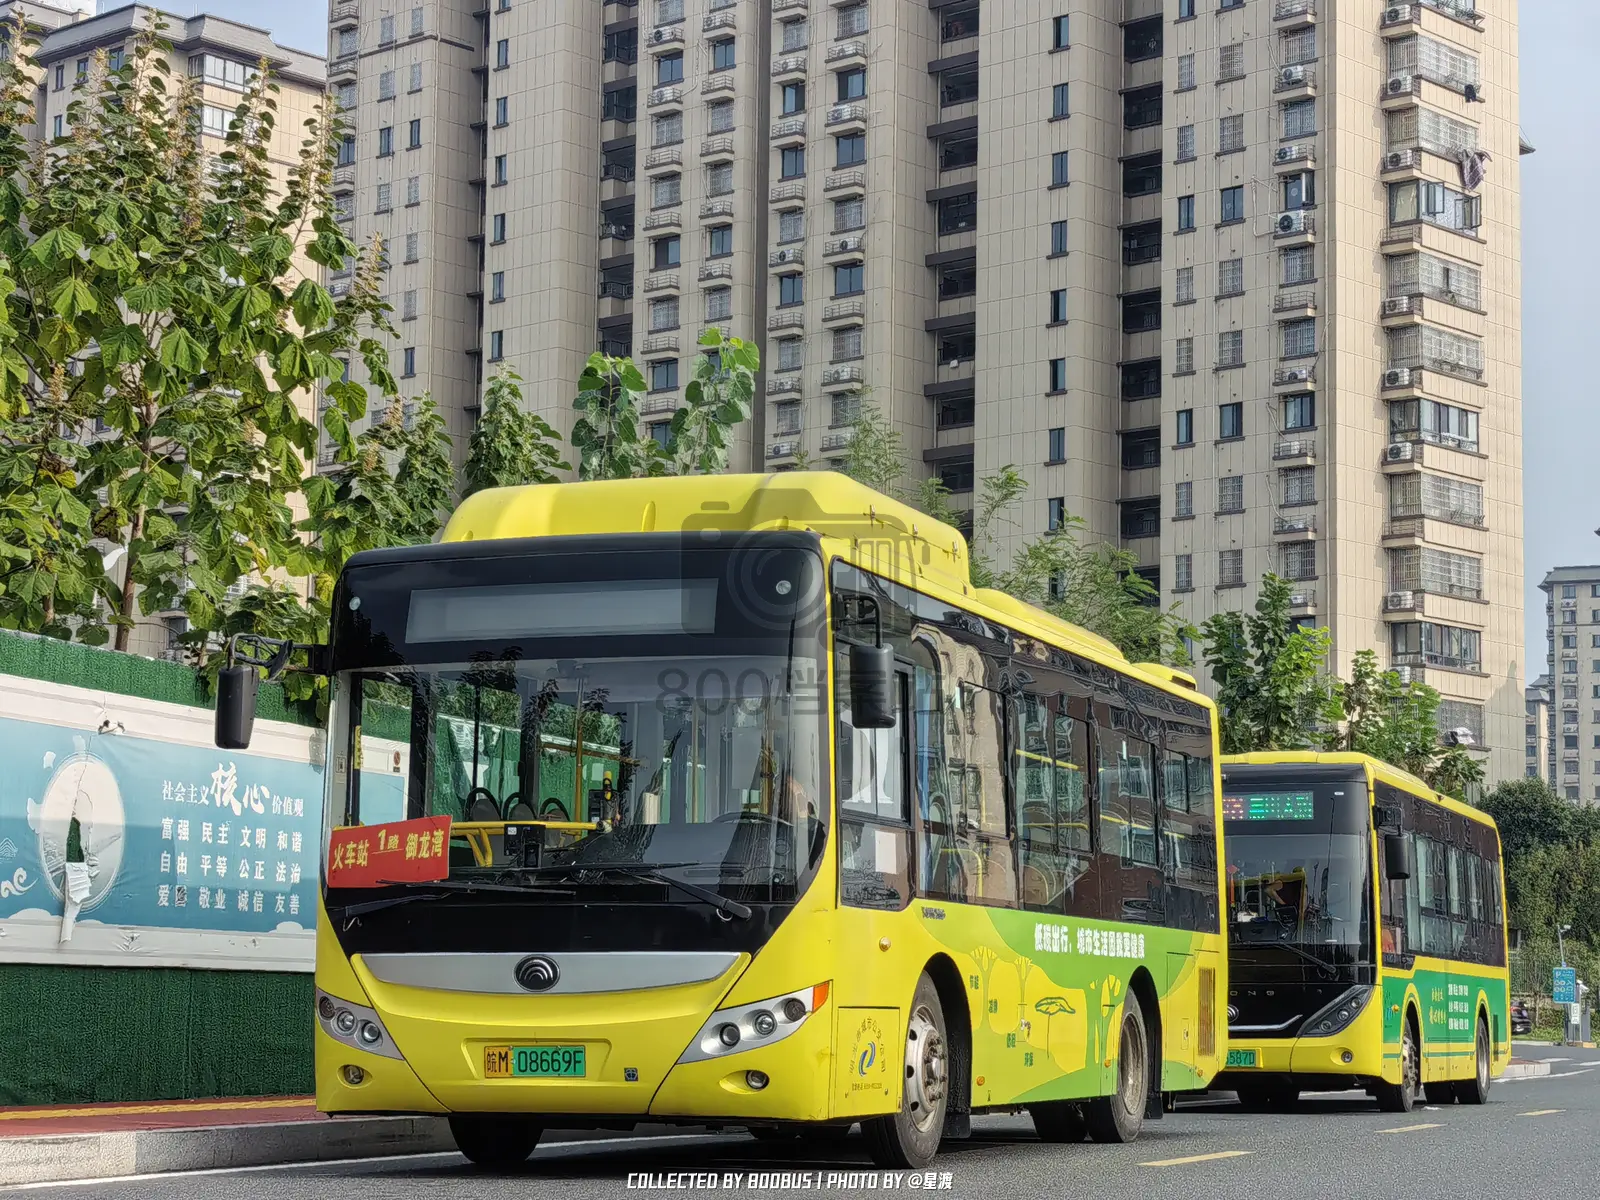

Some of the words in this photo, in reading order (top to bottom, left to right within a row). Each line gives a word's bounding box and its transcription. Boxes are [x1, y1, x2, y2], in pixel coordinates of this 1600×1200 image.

[162, 817, 190, 842] 富强
[201, 822, 229, 845] 民主
[239, 826, 267, 849] 文明
[277, 830, 303, 852] 和谐
[332, 840, 369, 870] 火车站
[405, 829, 444, 860] 御龙湾
[160, 851, 187, 875] 自由
[200, 854, 228, 877] 平等
[238, 858, 265, 880] 公正
[275, 861, 301, 884] 法治
[199, 887, 226, 909] 敬业
[237, 890, 264, 912] 诚信
[274, 893, 300, 915] 友善
